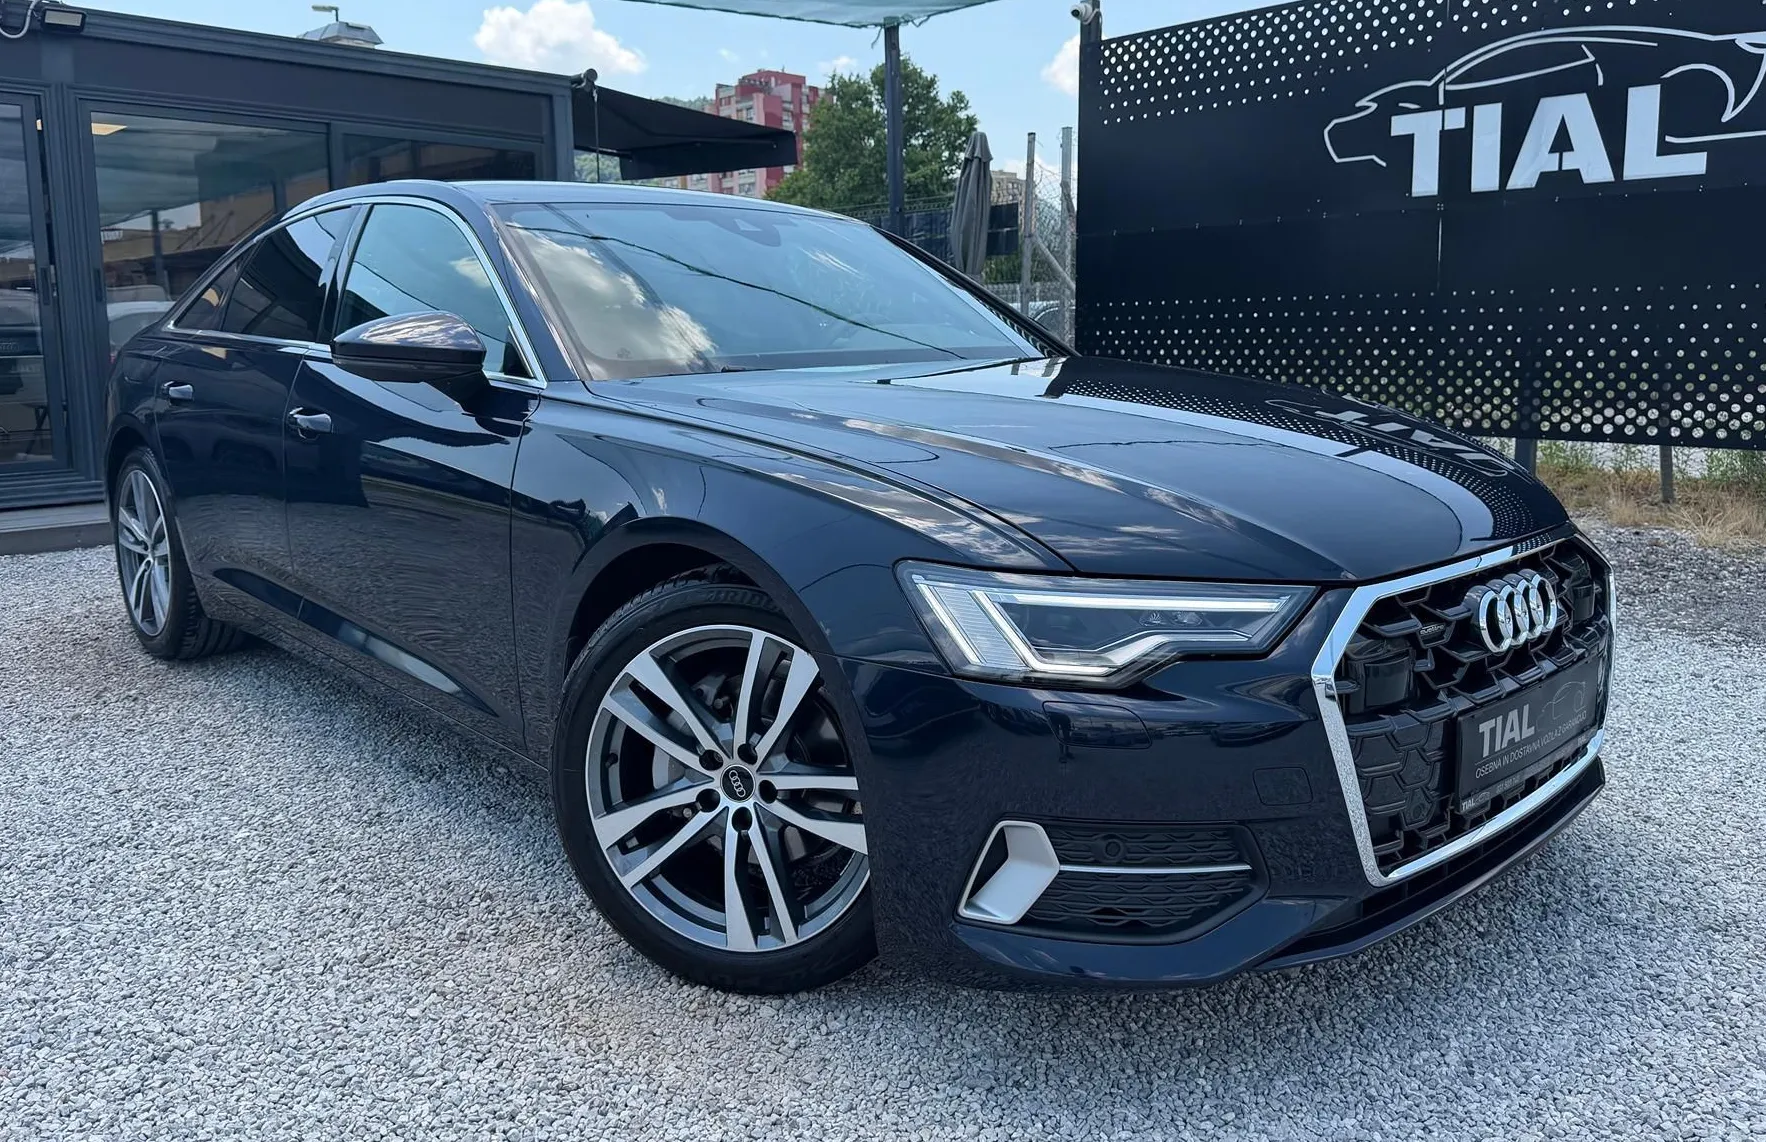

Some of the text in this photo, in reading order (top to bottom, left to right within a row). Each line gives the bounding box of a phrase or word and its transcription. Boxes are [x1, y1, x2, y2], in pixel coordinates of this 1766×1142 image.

[1390, 83, 1708, 197] TIAL
[1478, 703, 1535, 758] TIAL
[1475, 757, 1502, 779] OSEBNA
[1502, 754, 1509, 767] IN
[1509, 739, 1541, 763] DOSTAVNA
[1461, 797, 1476, 811] TIAL
